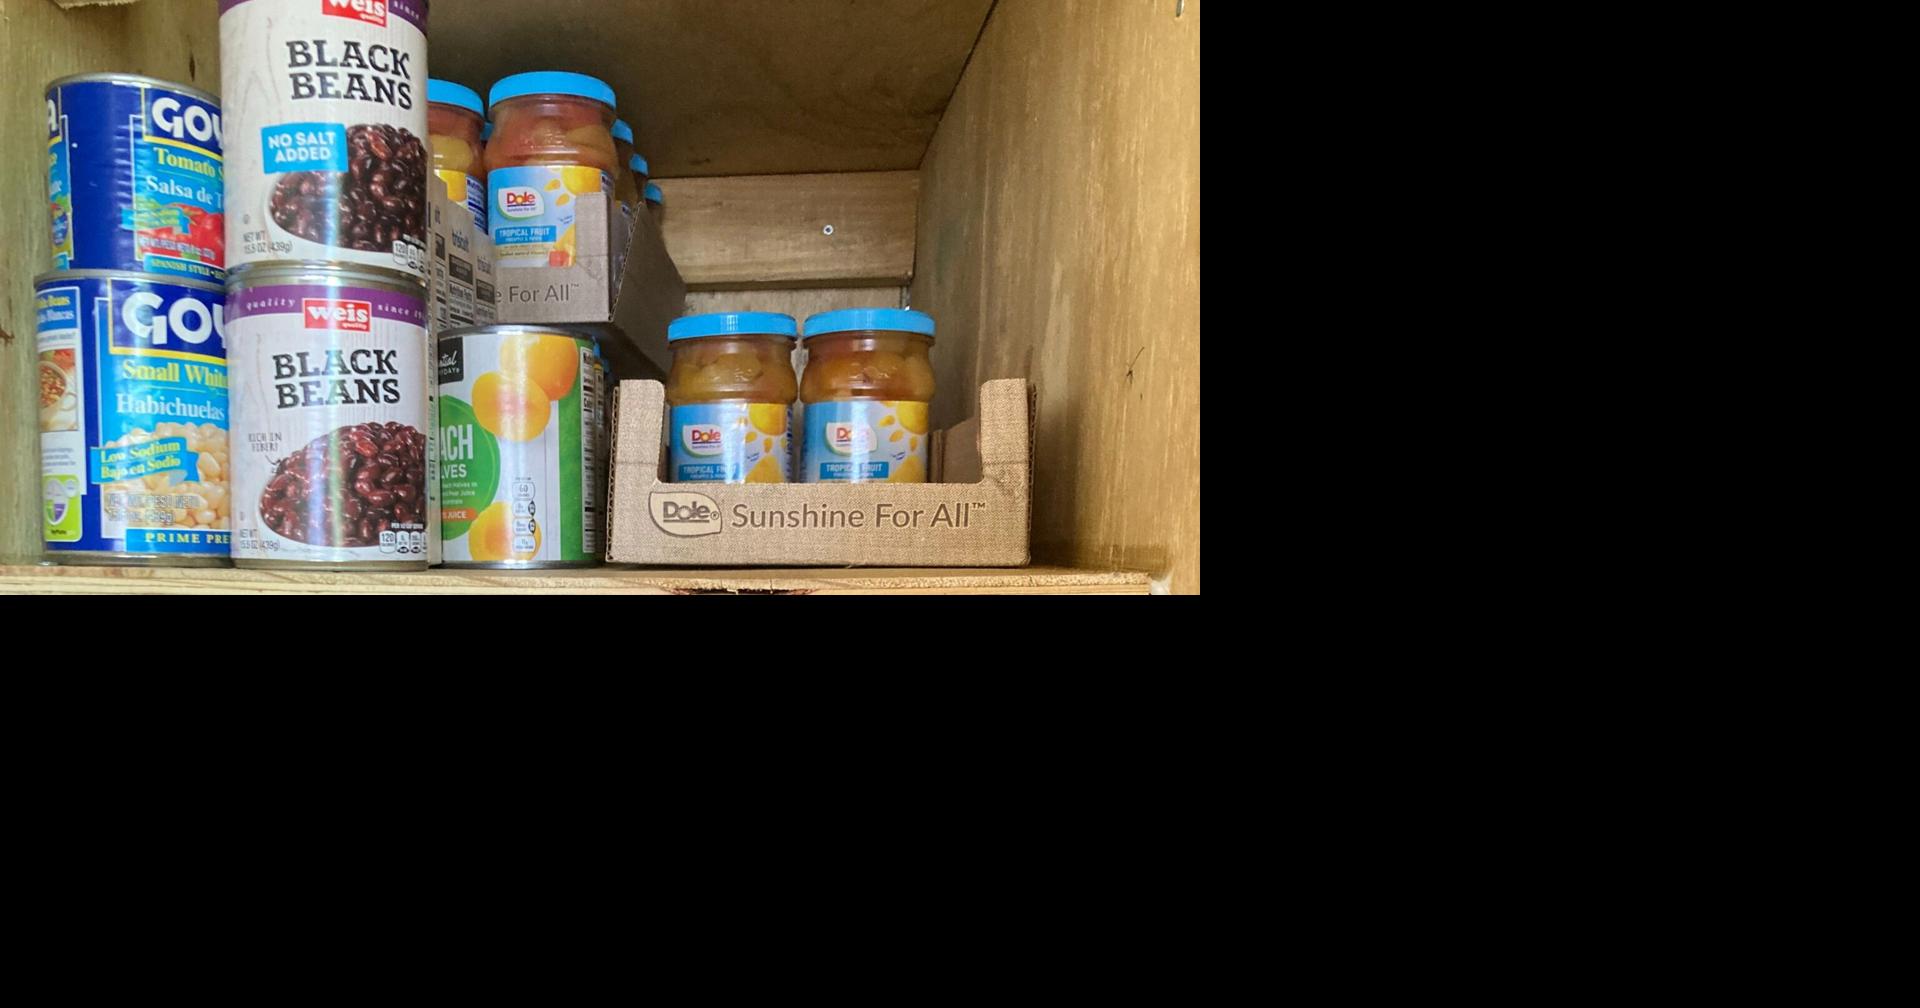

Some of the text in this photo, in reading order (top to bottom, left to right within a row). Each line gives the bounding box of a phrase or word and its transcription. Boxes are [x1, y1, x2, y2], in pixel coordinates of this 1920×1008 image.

[286, 39, 411, 80] BLACK
[289, 71, 413, 110] BEANS
[268, 131, 336, 149] NO SALT
[153, 146, 216, 178] Tomato
[274, 147, 331, 163] ADDED
[145, 175, 193, 200] Salsa
[196, 188, 213, 205] de
[506, 191, 536, 205] Dole
[530, 228, 550, 237] FRUIT
[508, 285, 540, 303] For
[246, 298, 296, 310] quality
[307, 304, 369, 323] weis
[377, 303, 410, 317] since
[122, 360, 180, 383] Small
[273, 349, 400, 380] BLACK
[276, 378, 401, 410] BEANS
[116, 392, 225, 420] Habichuelas
[691, 429, 721, 442] Dole
[100, 440, 181, 464] Low Sodium
[147, 454, 181, 471] Sodio
[732, 502, 865, 528] Sunshine
[876, 503, 924, 528] For
[145, 532, 201, 544] PRIME
